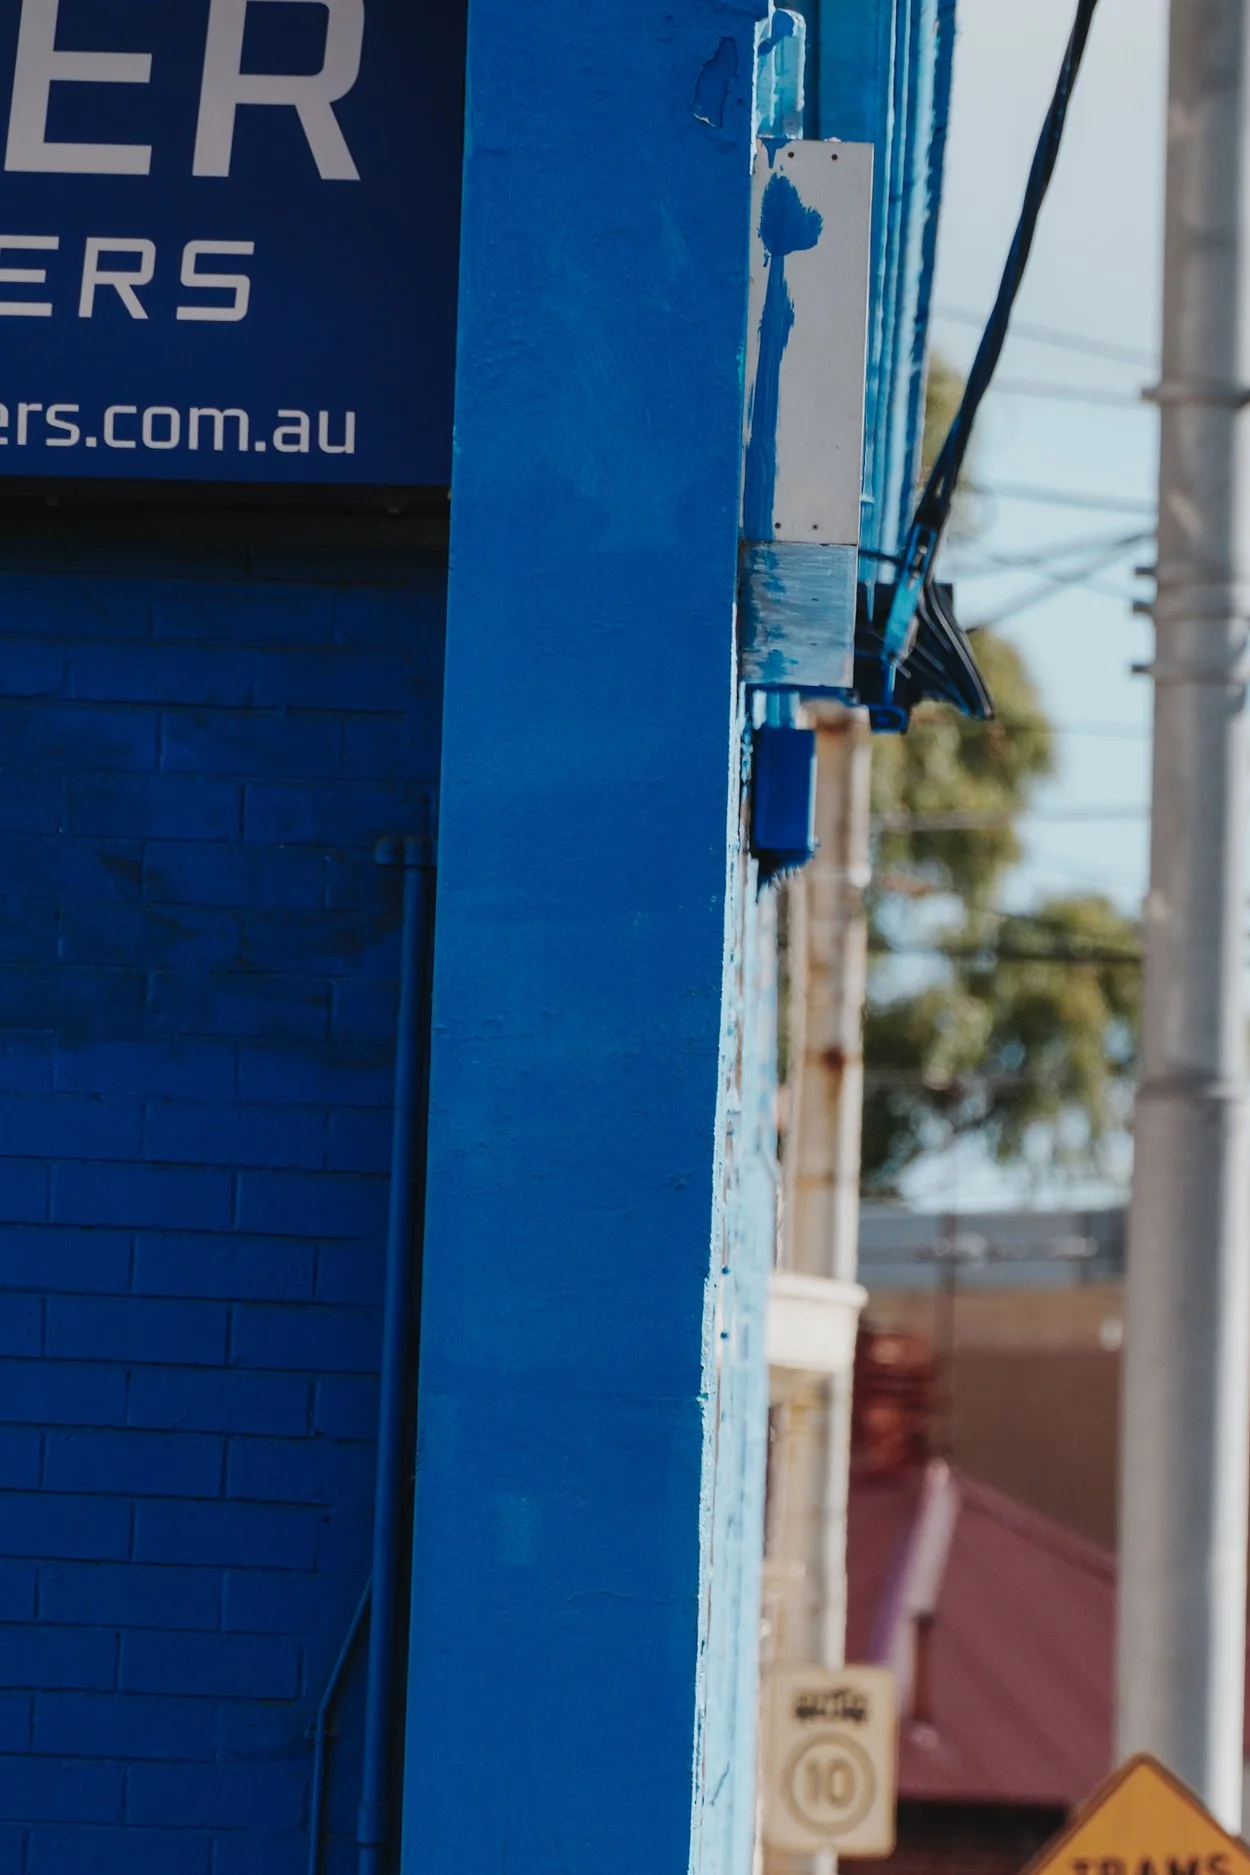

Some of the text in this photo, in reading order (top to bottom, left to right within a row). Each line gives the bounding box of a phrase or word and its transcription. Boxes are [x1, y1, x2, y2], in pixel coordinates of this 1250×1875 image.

[4, 0, 365, 181] ER
[0, 235, 255, 322] ERS
[0, 402, 356, 455] rs.com.au
[805, 1757, 854, 1810] 10
